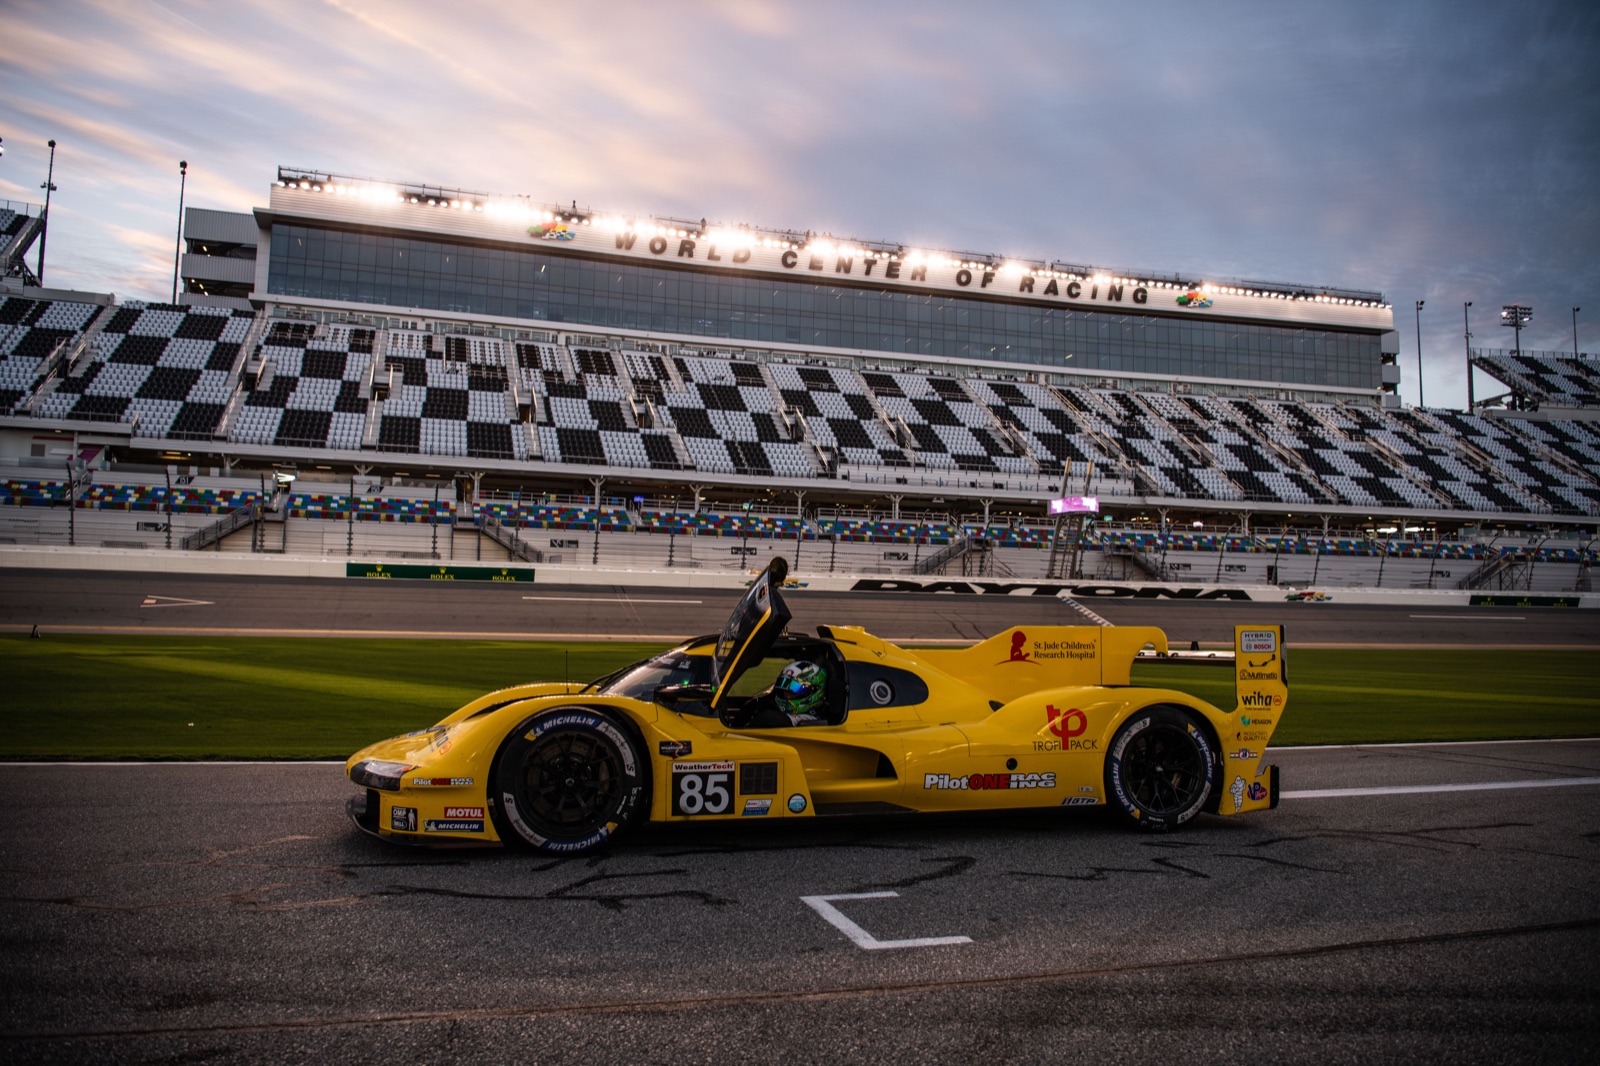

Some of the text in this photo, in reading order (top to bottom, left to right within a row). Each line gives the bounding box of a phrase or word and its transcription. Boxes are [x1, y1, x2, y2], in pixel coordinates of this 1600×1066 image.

[615, 232, 1148, 304] WORLD CENTER OF RACING
[850, 579, 1253, 600] DAYTONA
[1033, 641, 1096, 650] St. Jude Children's
[1034, 651, 1096, 660] Research Hospital
[1247, 672, 1278, 680] Multimatic
[1242, 691, 1272, 706] wiha
[543, 715, 596, 730] MICHELIN
[1032, 739, 1098, 752] TROFI PACK
[1197, 736, 1213, 779] MICHELIN
[626, 763, 635, 773] S
[674, 763, 732, 771] WeatherTech
[1112, 762, 1130, 806] MICHELIN
[1248, 782, 1262, 800] VP
[505, 796, 513, 804] S
[679, 774, 730, 815] 85
[446, 808, 483, 818] MOTUL
[548, 834, 601, 851] MICHELIN
